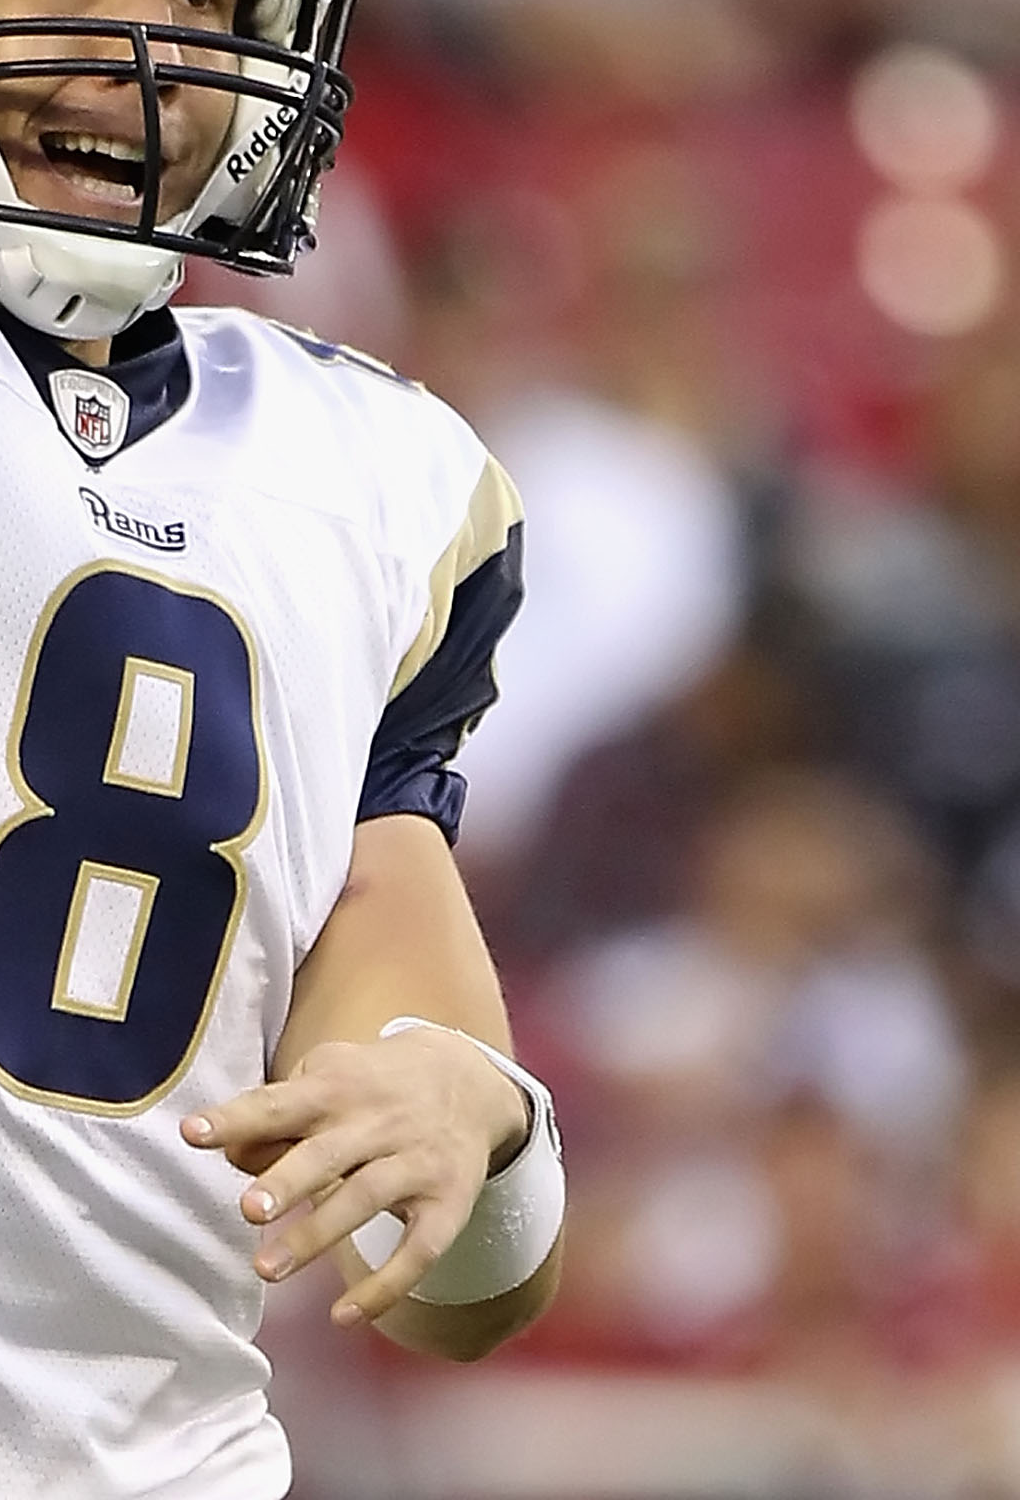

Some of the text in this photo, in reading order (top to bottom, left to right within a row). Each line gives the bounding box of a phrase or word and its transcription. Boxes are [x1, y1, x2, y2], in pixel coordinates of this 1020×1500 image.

[226, 106, 294, 184] Ridde
[79, 415, 109, 441] NFL
[79, 486, 186, 551] Rams
